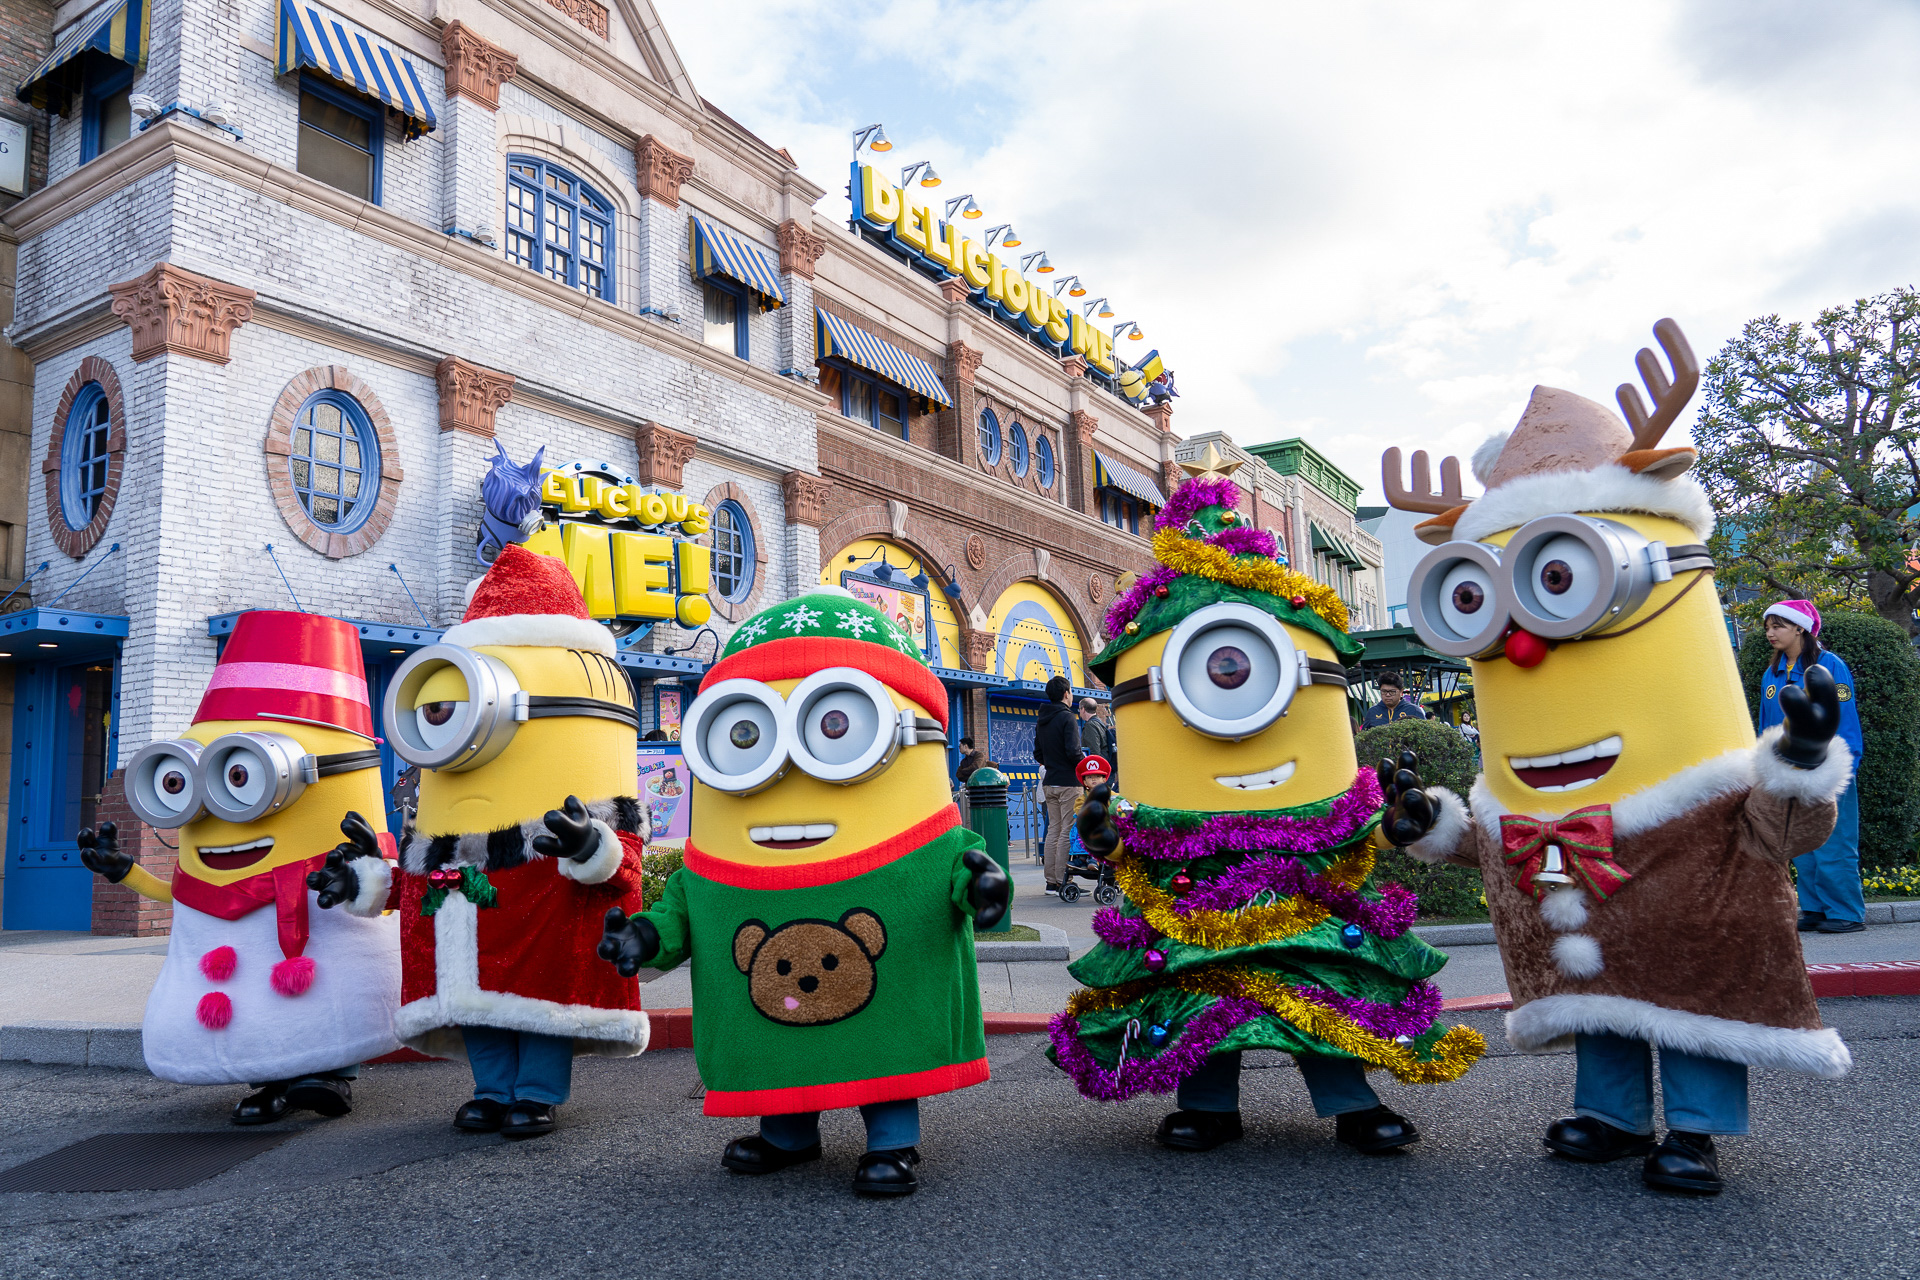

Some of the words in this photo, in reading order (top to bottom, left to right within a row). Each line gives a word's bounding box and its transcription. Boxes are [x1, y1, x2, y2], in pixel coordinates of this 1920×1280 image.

[862, 165, 1070, 343] DELICIOUS
[1072, 313, 1115, 375] ME
[540, 467, 710, 535] ELICIOUS
[522, 522, 711, 627] ME!
